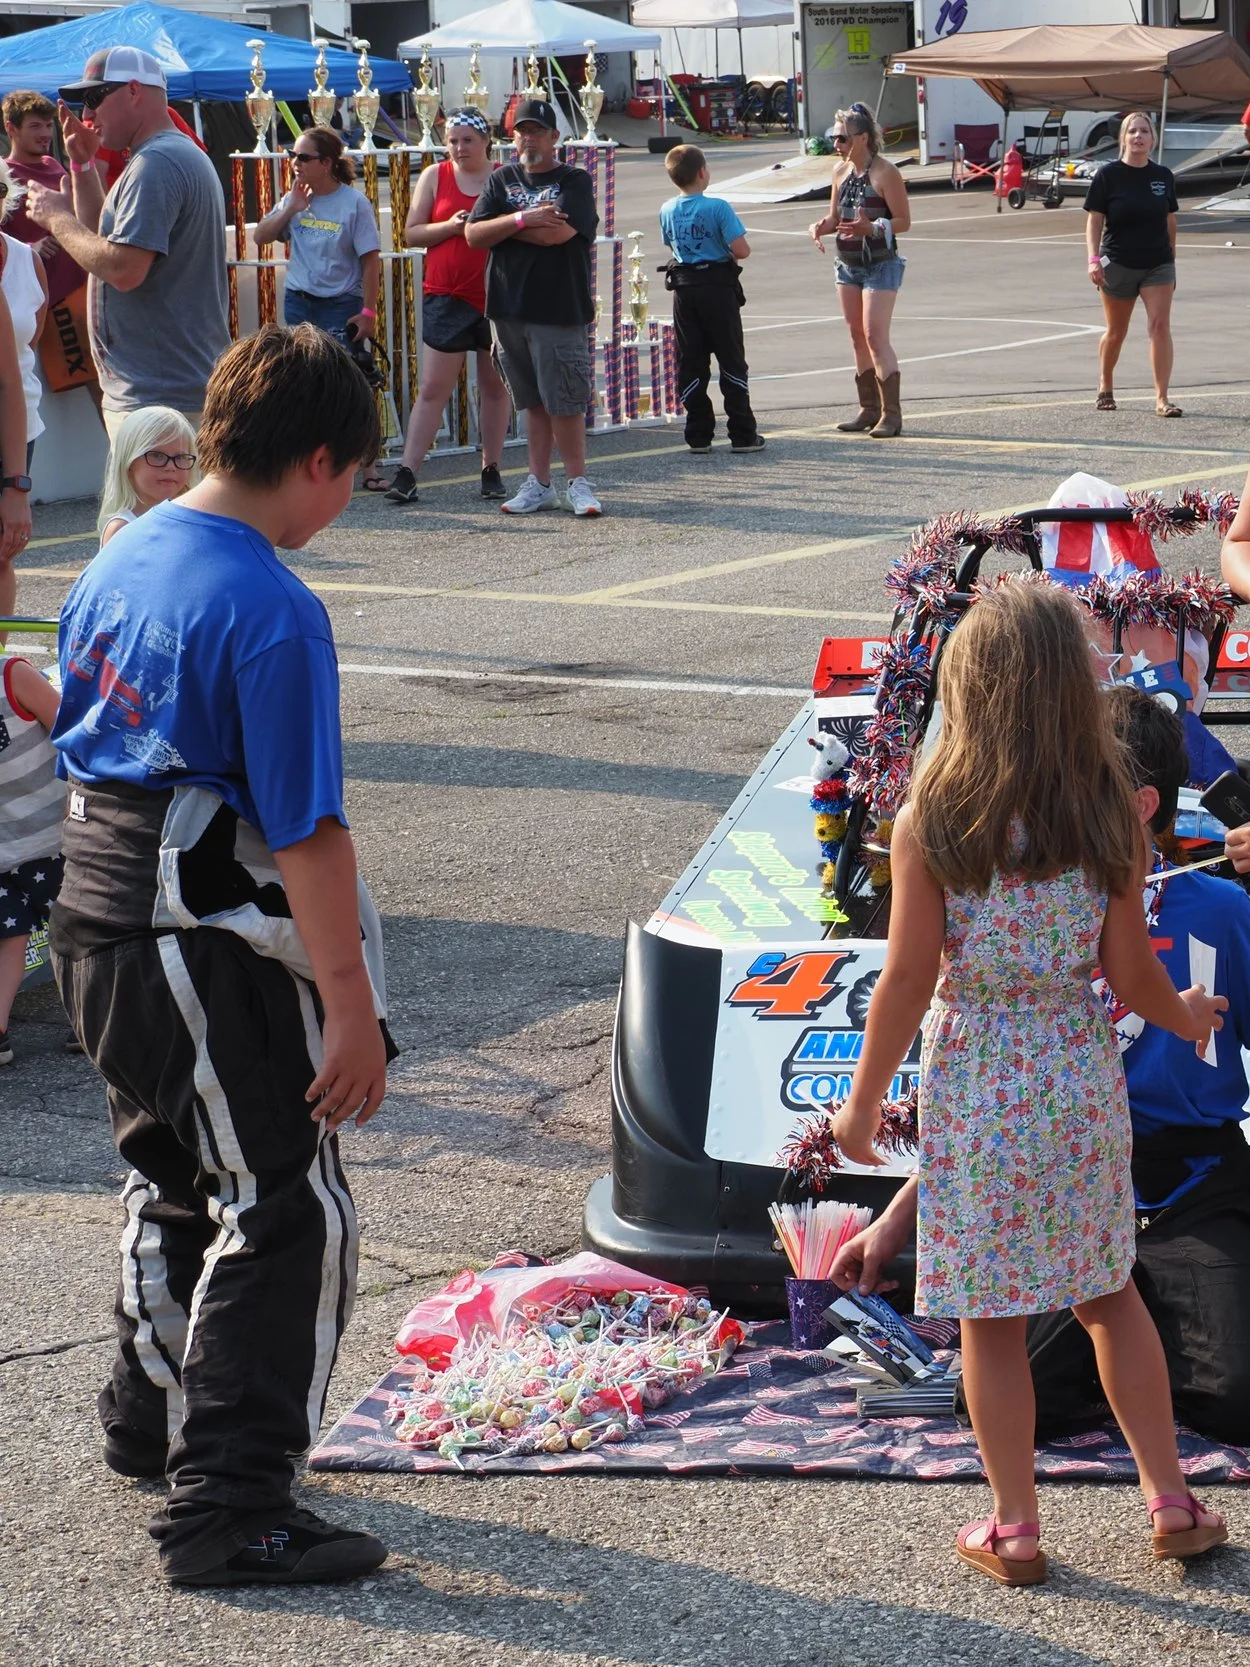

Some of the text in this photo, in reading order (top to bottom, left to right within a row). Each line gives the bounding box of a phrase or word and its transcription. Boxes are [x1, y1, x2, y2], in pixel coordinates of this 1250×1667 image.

[808, 5, 906, 17] South Bend Motor Speedway
[814, 15, 899, 26] 2016 FWD Champion
[706, 869, 793, 928] Speedway
